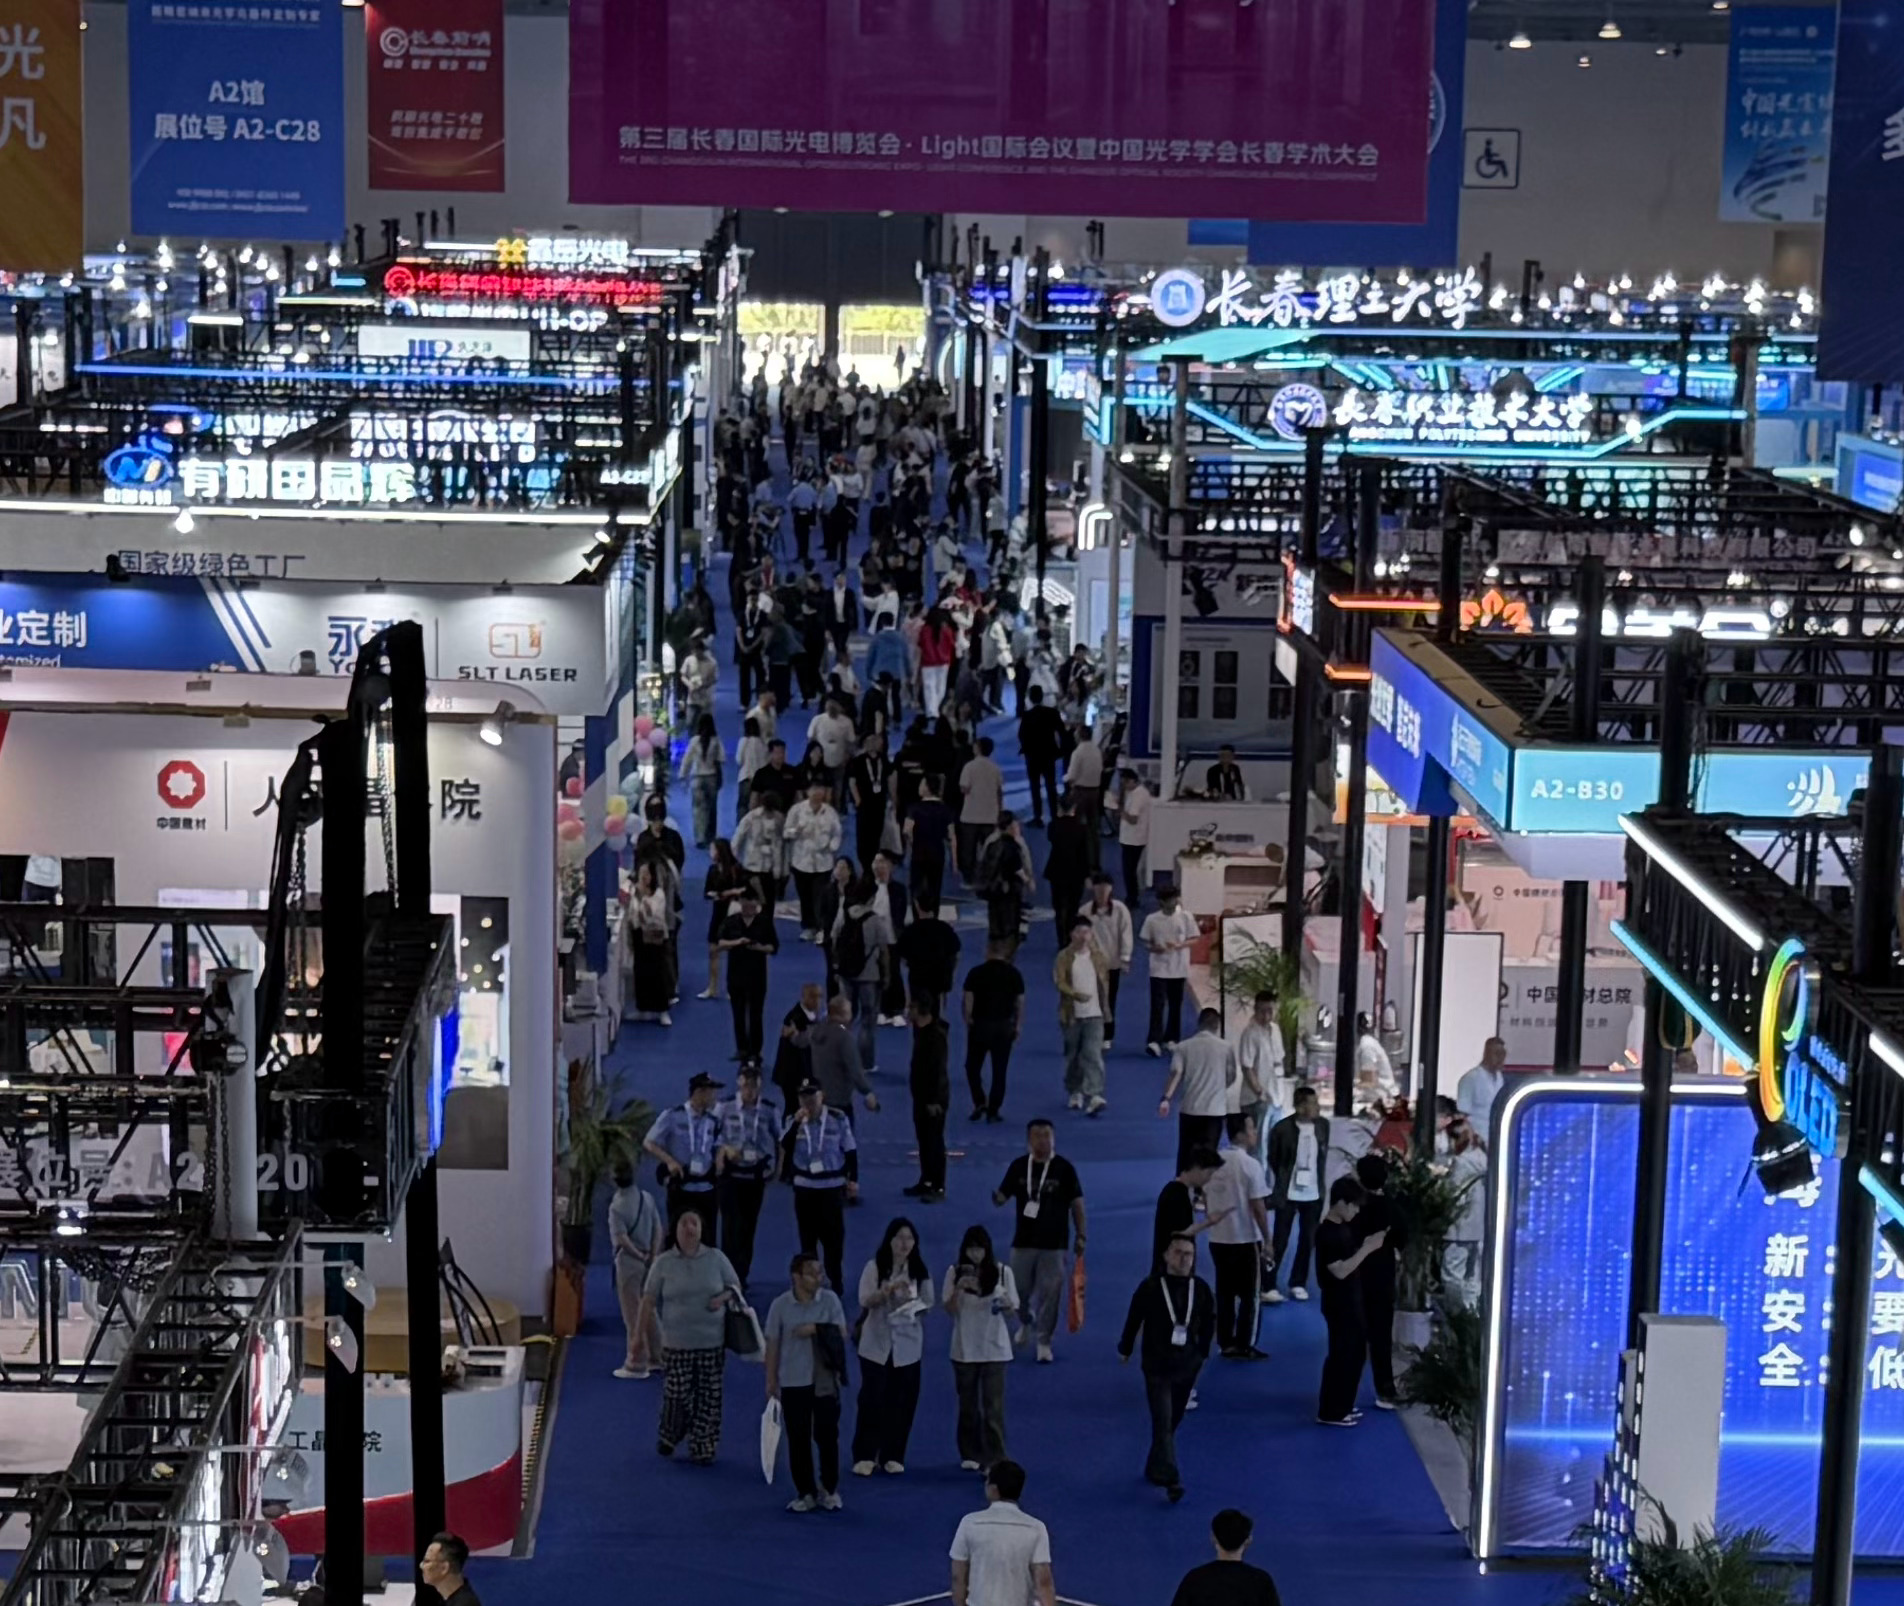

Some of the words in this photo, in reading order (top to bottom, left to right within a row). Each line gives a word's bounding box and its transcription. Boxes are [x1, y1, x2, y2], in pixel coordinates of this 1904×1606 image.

[207, 79, 266, 105] A2馆
[154, 114, 228, 141] 展位号
[233, 117, 320, 142] A2-C28
[1206, 270, 1478, 331] 长春理工大学
[1328, 387, 1589, 430] 长春职业技术大学
[119, 550, 307, 578] 国家级绿色工厂
[458, 665, 498, 680] SLT
[504, 665, 575, 682] LASER
[1530, 779, 1624, 801] A2-B30
[1526, 985, 1632, 1005] 中国材总院
